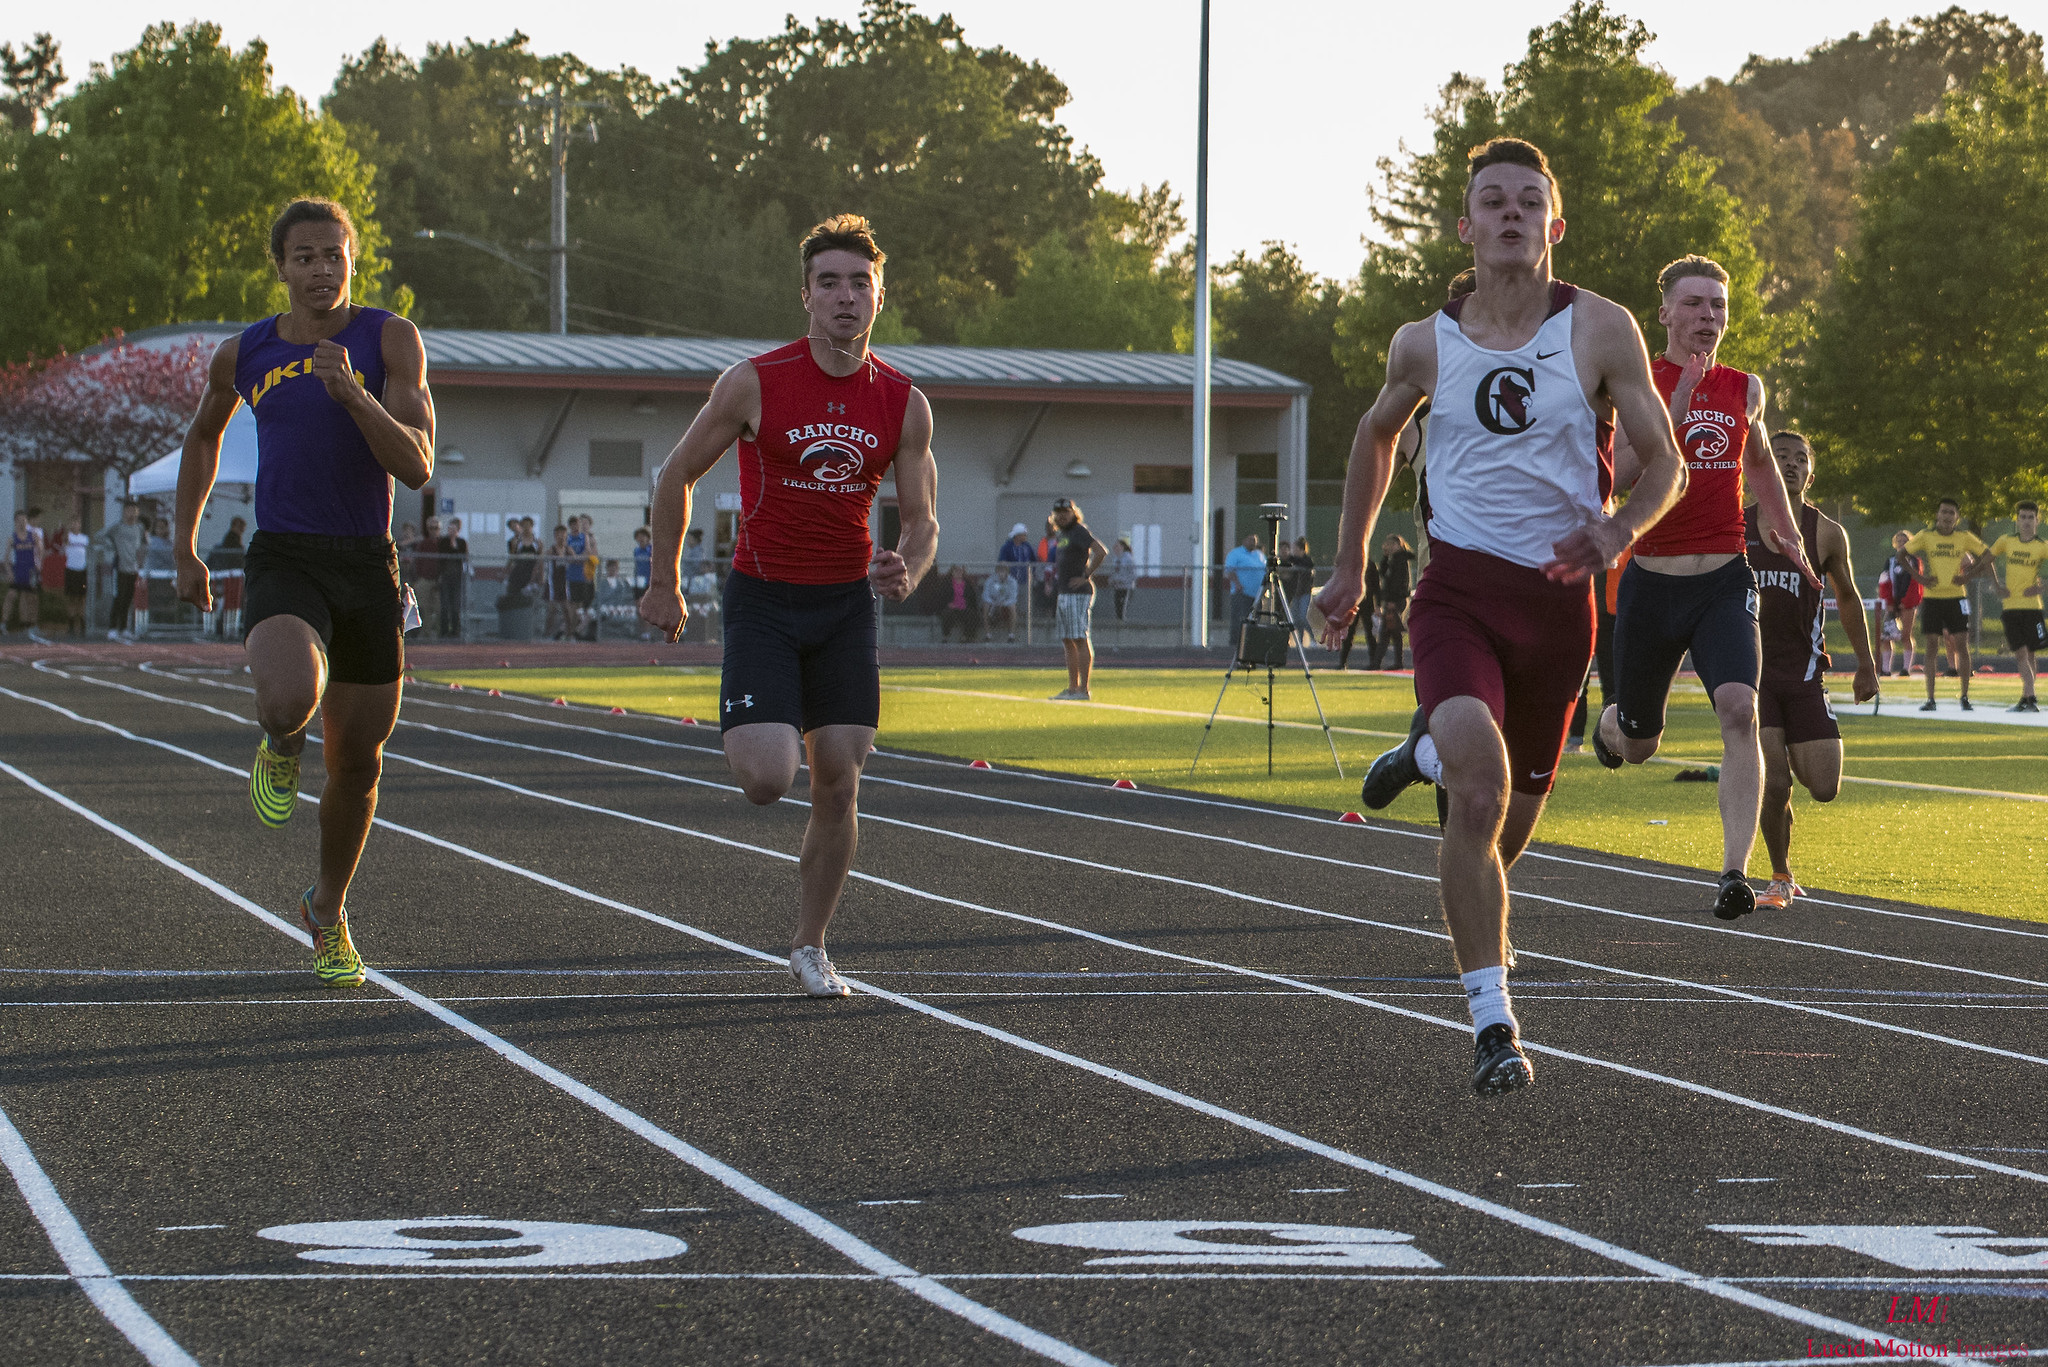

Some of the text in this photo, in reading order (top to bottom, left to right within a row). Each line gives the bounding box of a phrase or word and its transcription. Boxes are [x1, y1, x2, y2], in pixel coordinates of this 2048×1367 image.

[252, 357, 365, 408] UKI
[1682, 410, 1736, 428] ANCHO
[785, 423, 879, 449] RANCHO
[1713, 460, 1737, 469] FIELD
[782, 477, 867, 493] TRACK & FIELD
